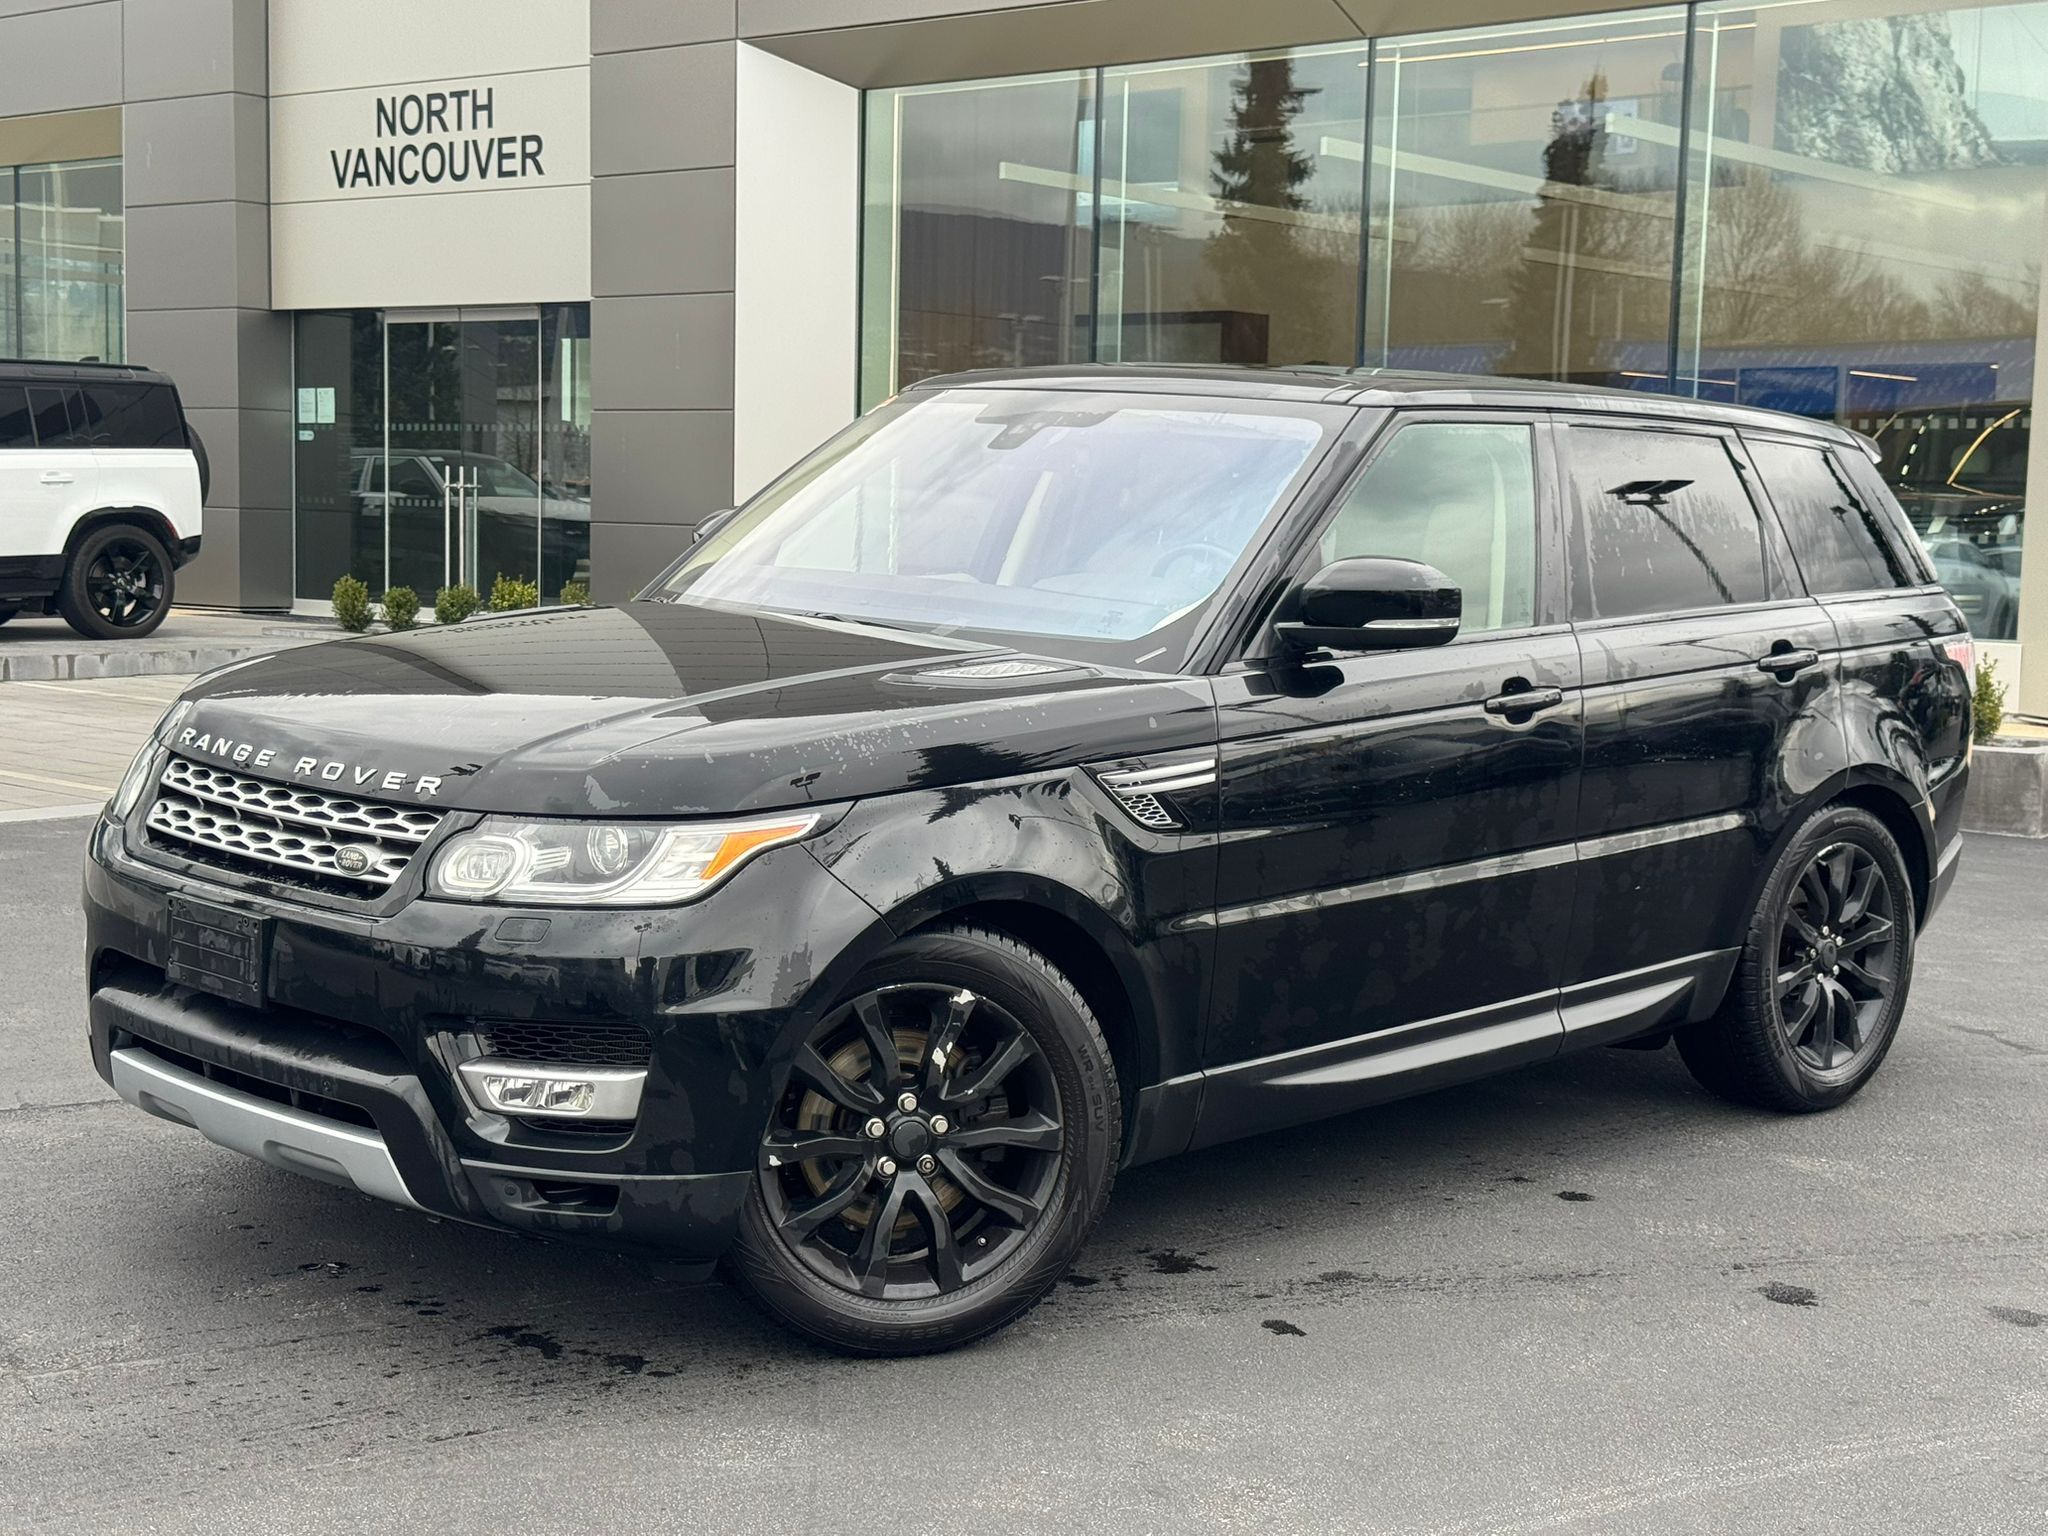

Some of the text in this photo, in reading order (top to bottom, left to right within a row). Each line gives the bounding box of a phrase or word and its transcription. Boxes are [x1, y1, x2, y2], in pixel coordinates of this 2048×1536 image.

[376, 87, 493, 138] NORTH
[330, 134, 545, 189] VANCOUVER
[178, 727, 442, 796] RANGE ROVER
[1091, 1093, 1105, 1132] SUV
